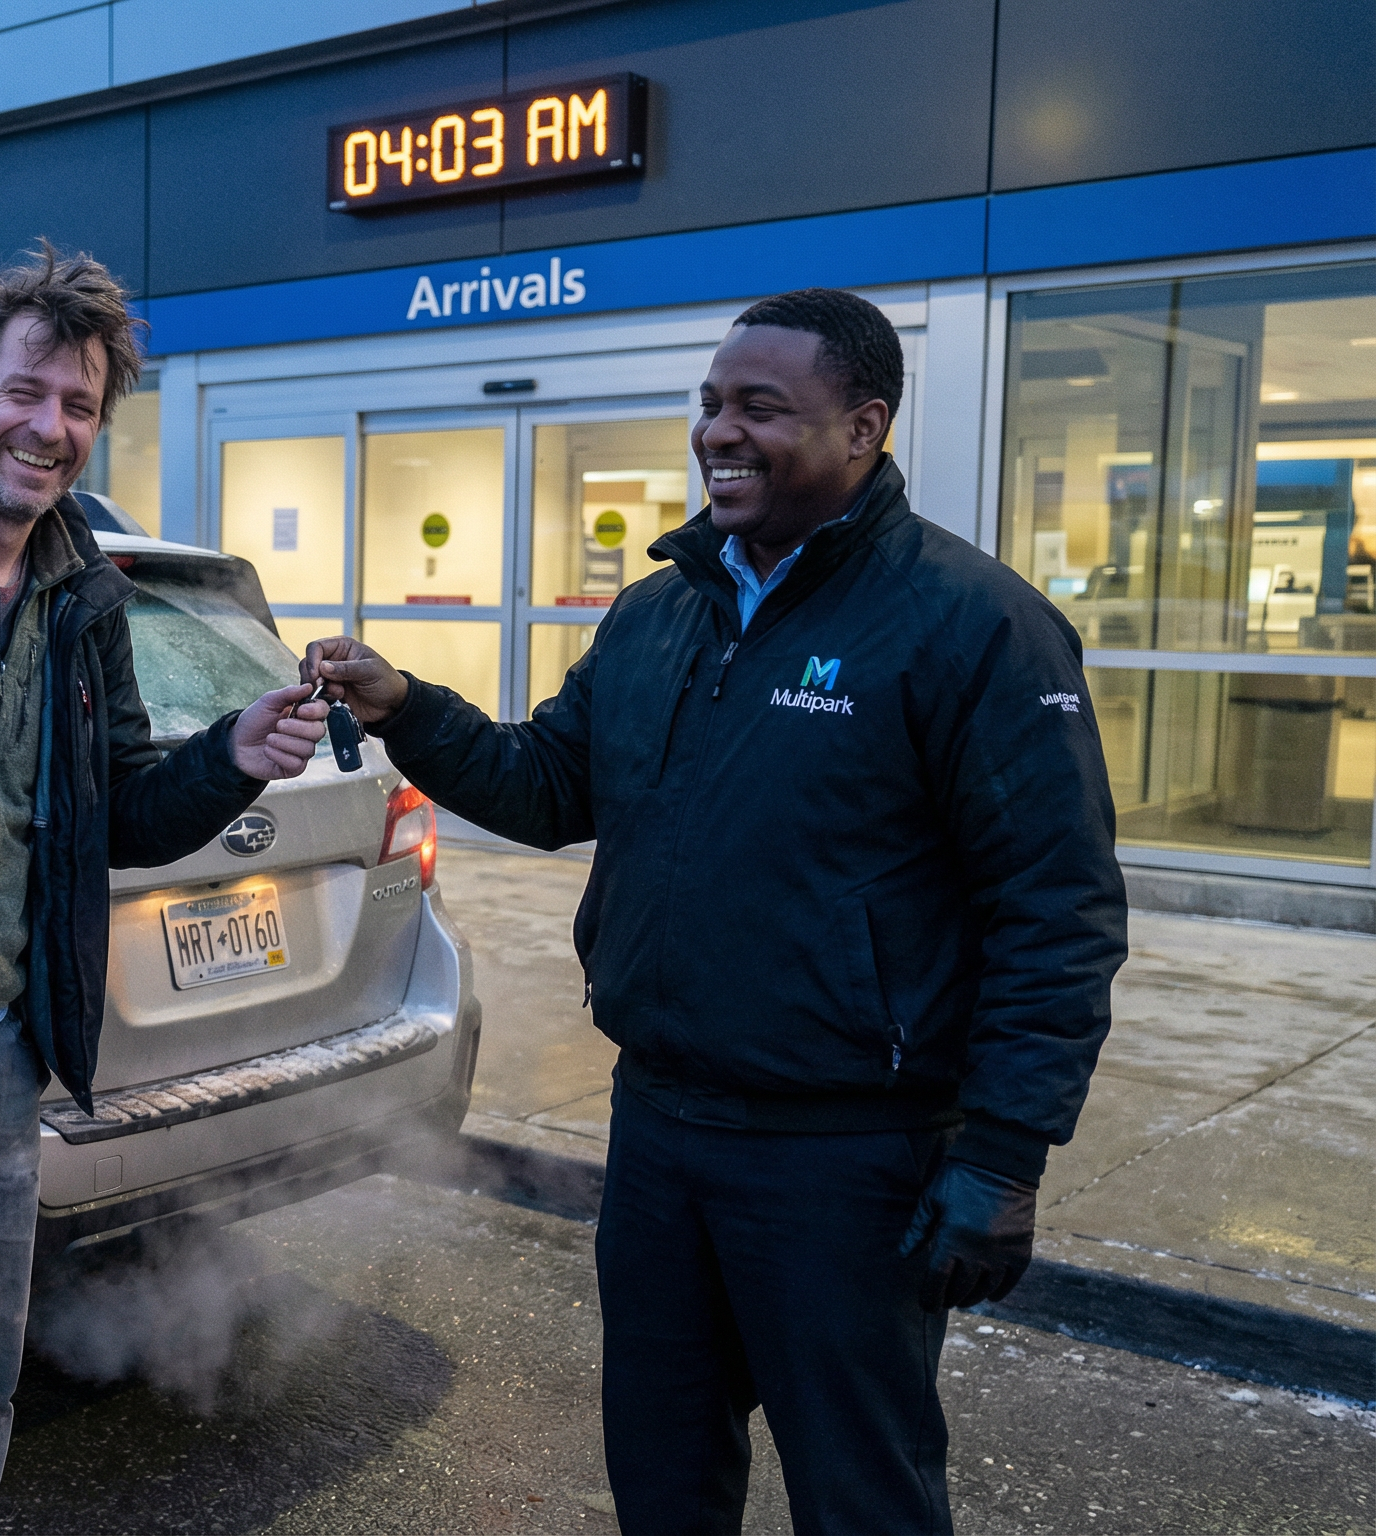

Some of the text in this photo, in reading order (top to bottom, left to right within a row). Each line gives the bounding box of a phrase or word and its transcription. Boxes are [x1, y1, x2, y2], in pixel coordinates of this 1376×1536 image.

[344, 89, 608, 197] 04:03 AM
[406, 257, 586, 320] Arrivals
[770, 688, 855, 716] Multipark
